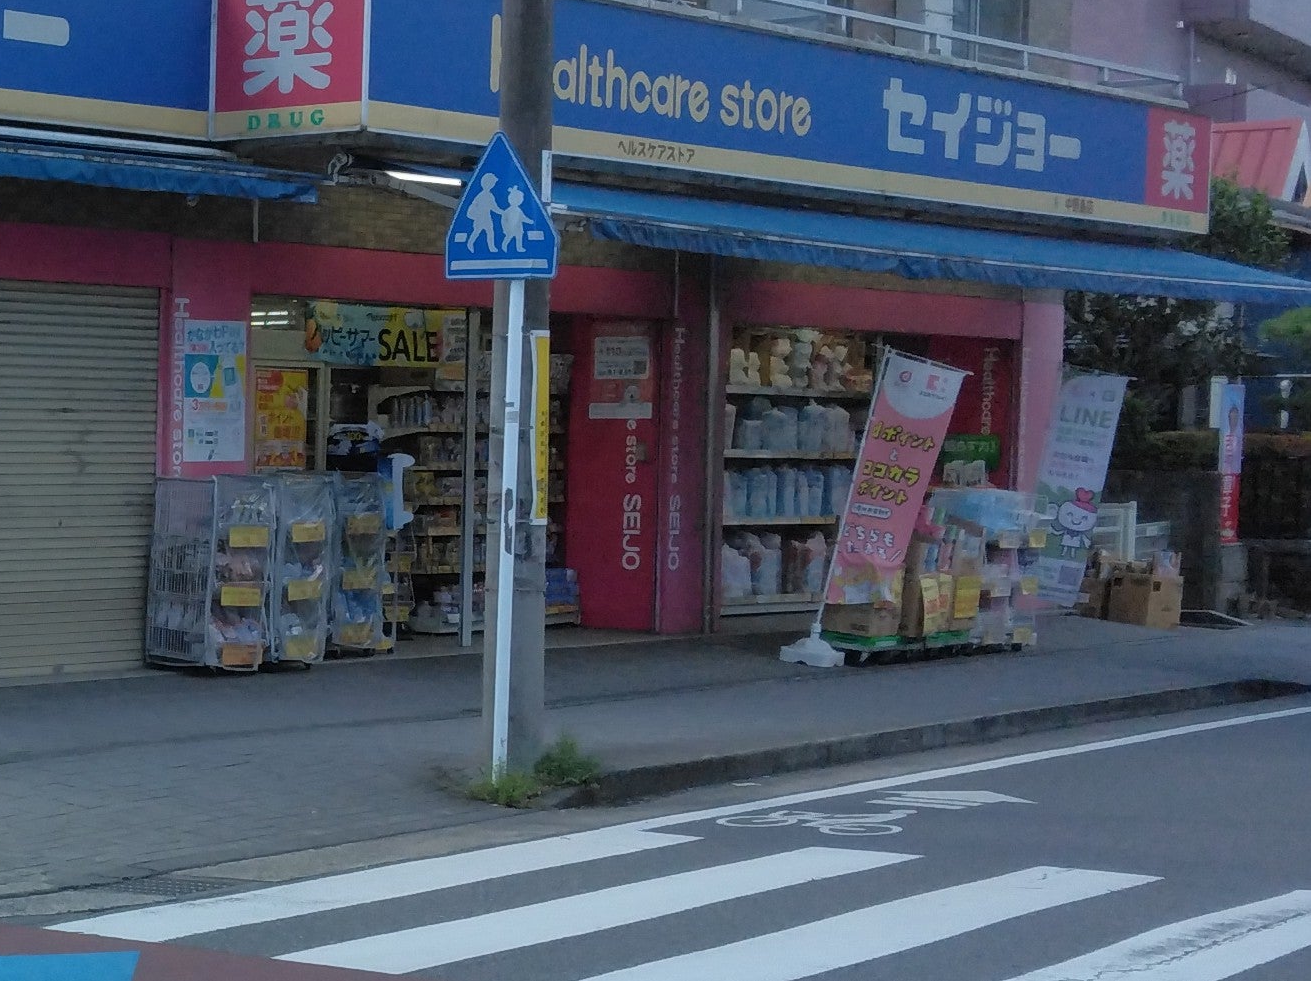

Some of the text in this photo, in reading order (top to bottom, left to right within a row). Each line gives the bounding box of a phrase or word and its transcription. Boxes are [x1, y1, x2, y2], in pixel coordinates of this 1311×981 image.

[490, 14, 812, 137] althcare store
[248, 108, 326, 131] DRUG
[883, 77, 1081, 172] セイジョー
[617, 139, 696, 164] ヘルスケアストア
[1161, 120, 1196, 201] 薬
[378, 328, 439, 362] SALE
[1059, 404, 1115, 429] LINE
[172, 429, 184, 478] stor
[625, 435, 638, 484] store
[671, 435, 680, 484] store
[862, 460, 920, 487] ココカラ
[857, 480, 909, 506] ポイント
[622, 494, 641, 570] SEIJO
[668, 494, 682, 571] SEIJO
